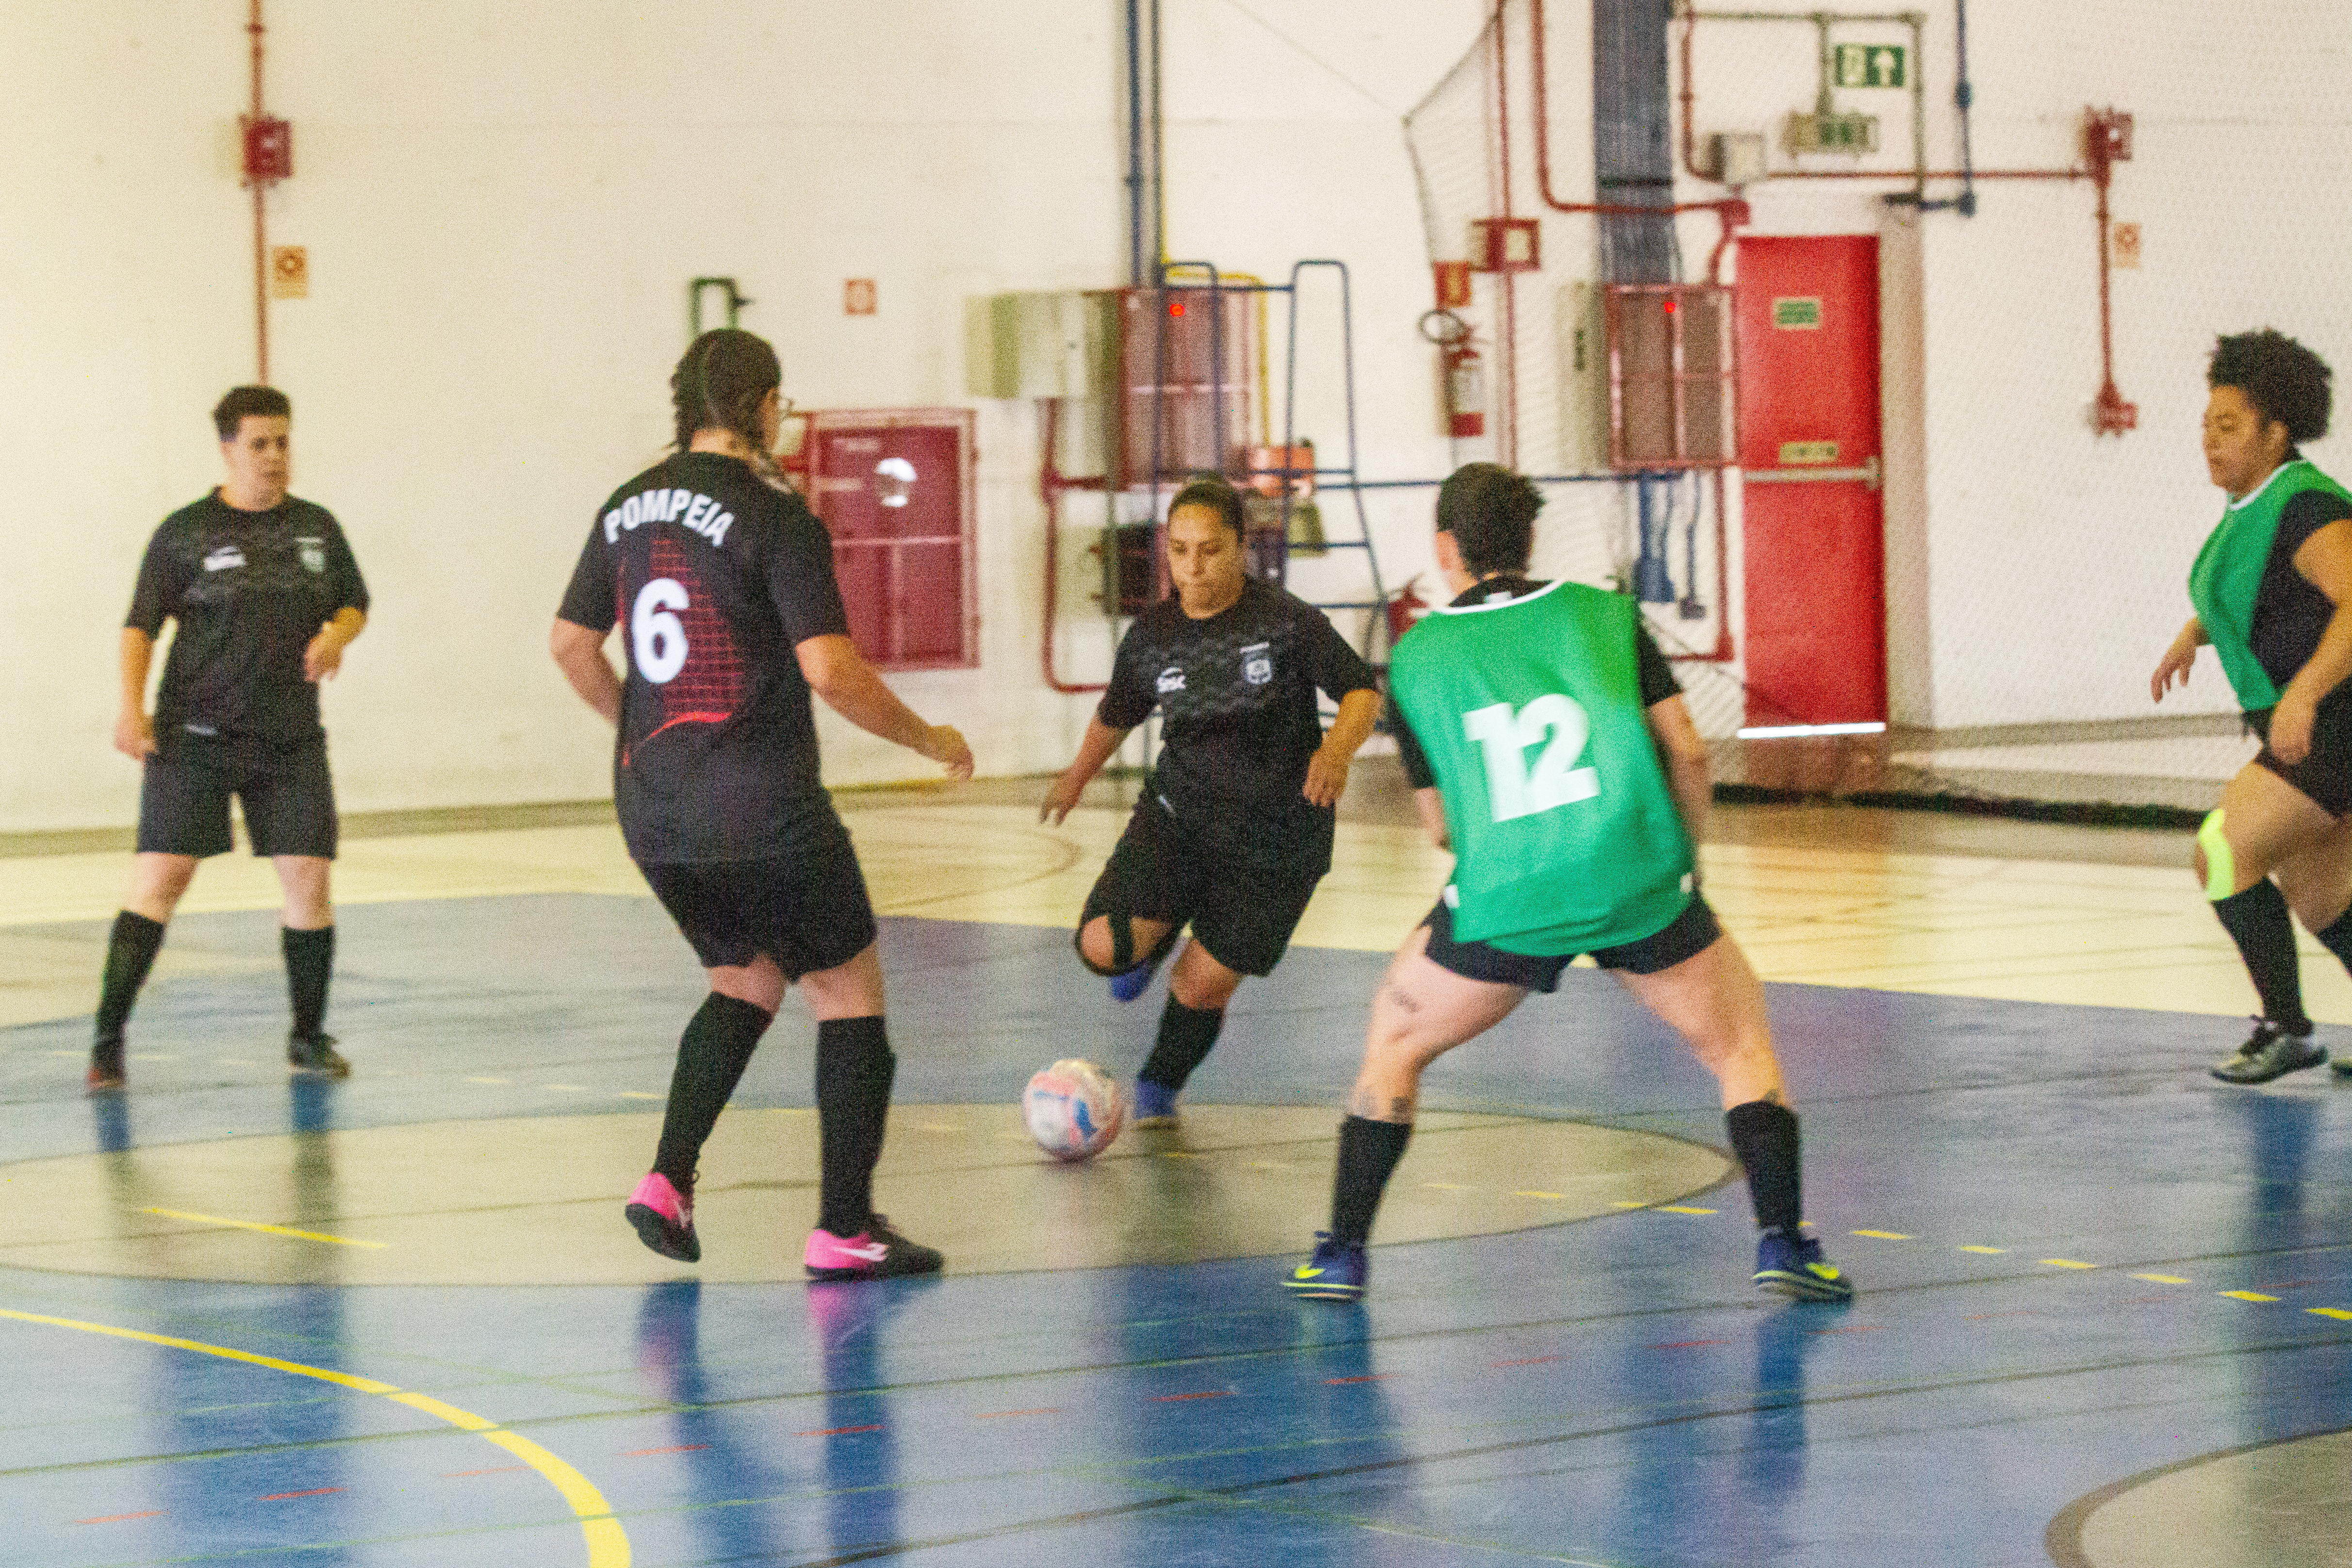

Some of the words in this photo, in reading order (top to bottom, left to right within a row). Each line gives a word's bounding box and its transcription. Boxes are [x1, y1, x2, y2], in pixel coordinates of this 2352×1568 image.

[603, 488, 735, 546] POMPEIA
[632, 578, 690, 684] 6
[1461, 693, 1600, 823] 12
